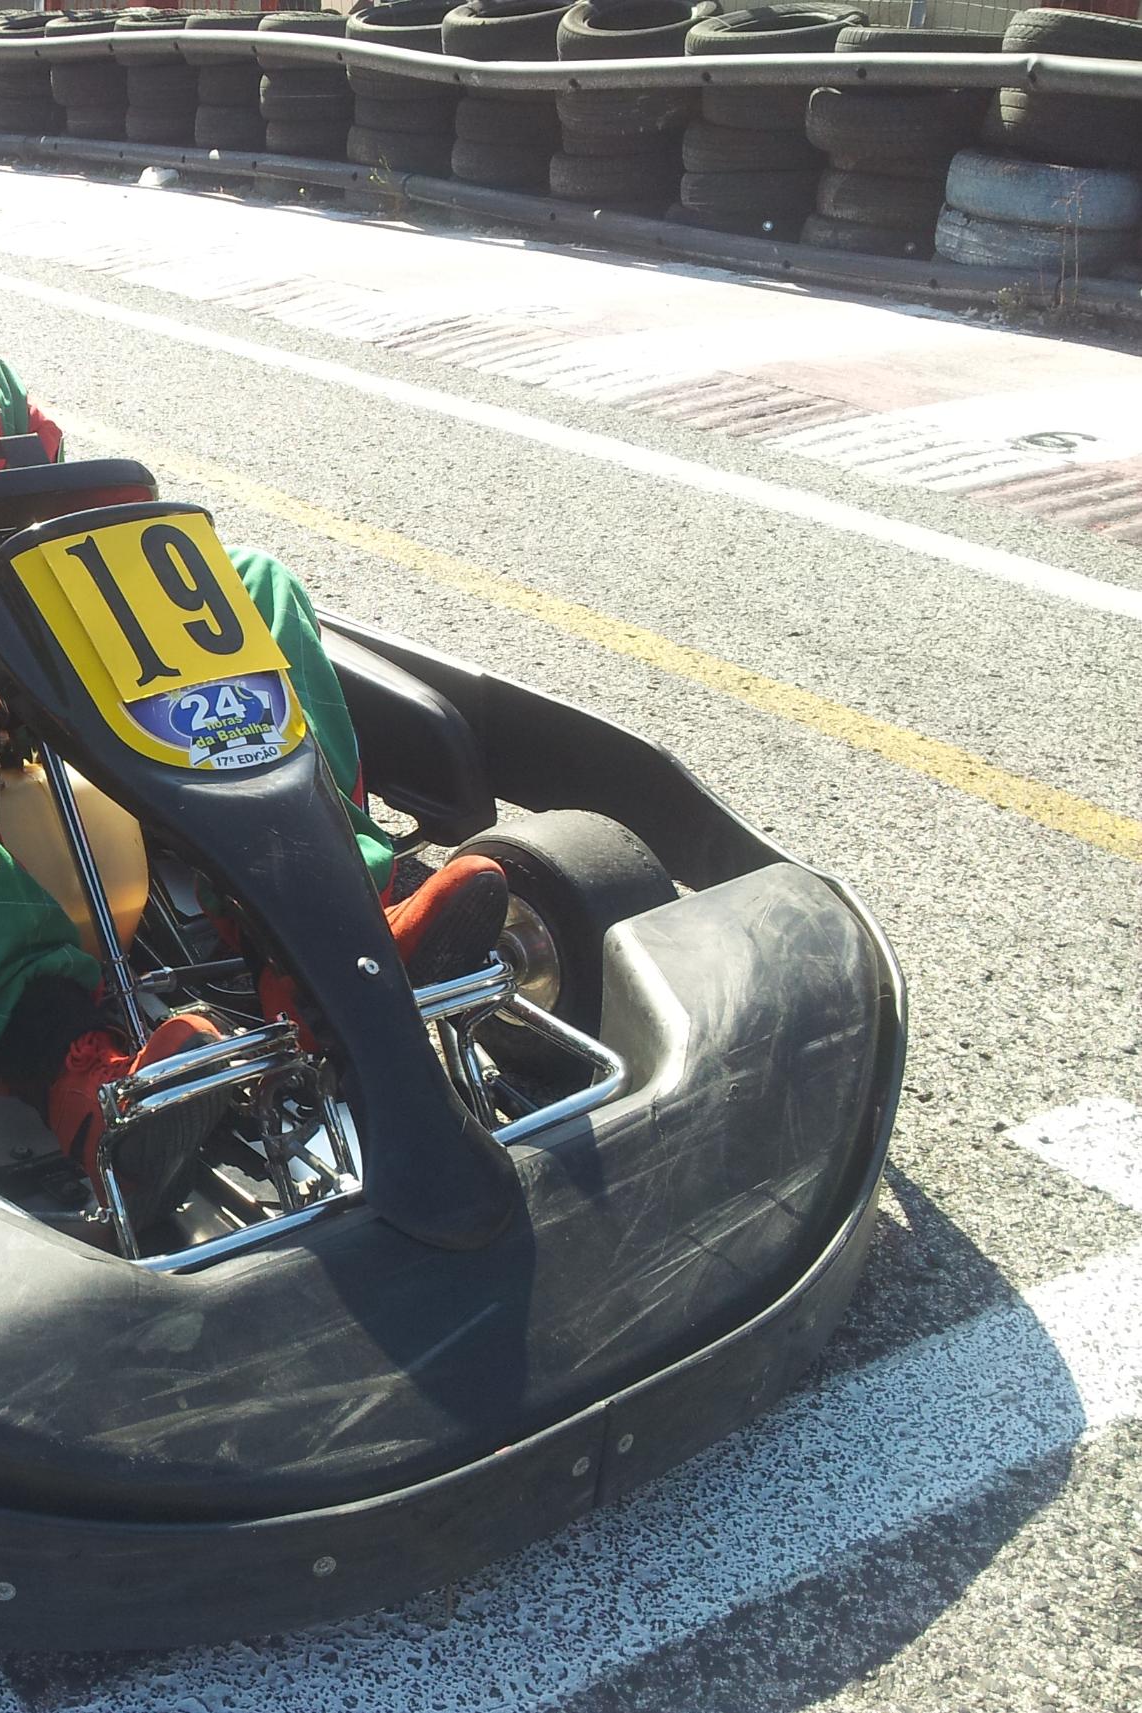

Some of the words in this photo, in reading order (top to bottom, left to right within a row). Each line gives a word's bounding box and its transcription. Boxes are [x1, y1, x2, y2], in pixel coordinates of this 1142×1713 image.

[65, 523, 245, 687] 19
[180, 686, 247, 731] 24
[195, 736, 216, 748] da
[216, 723, 271, 742] Batalha
